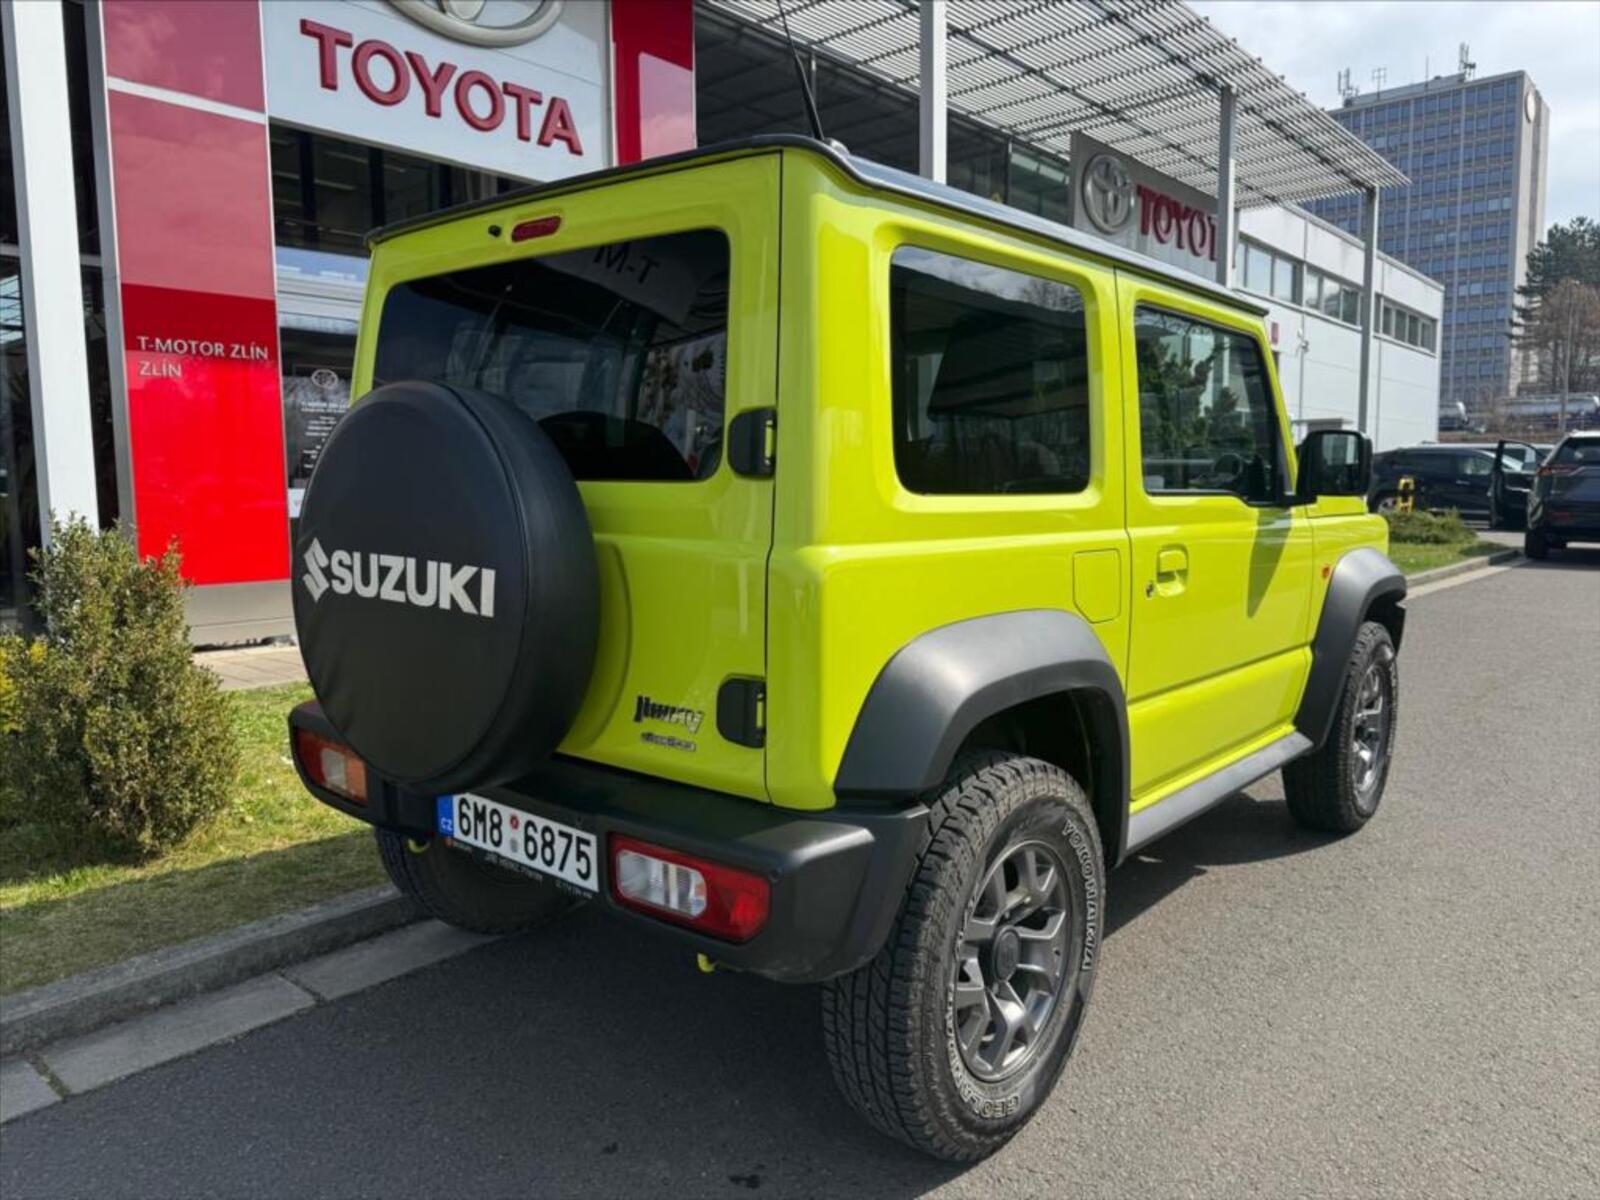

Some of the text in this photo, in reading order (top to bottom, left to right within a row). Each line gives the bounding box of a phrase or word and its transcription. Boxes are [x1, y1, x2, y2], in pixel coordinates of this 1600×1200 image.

[300, 18, 584, 157] TOYOTA
[1136, 184, 1219, 262] TOYOT
[137, 335, 268, 360] T-MOTOR ZLÍN
[139, 357, 182, 377] ZLÍN
[330, 549, 496, 618] SUZUKI
[458, 797, 503, 848] 6M8
[524, 820, 591, 881] 6875
[1062, 819, 1098, 971] YOKOHAMA
